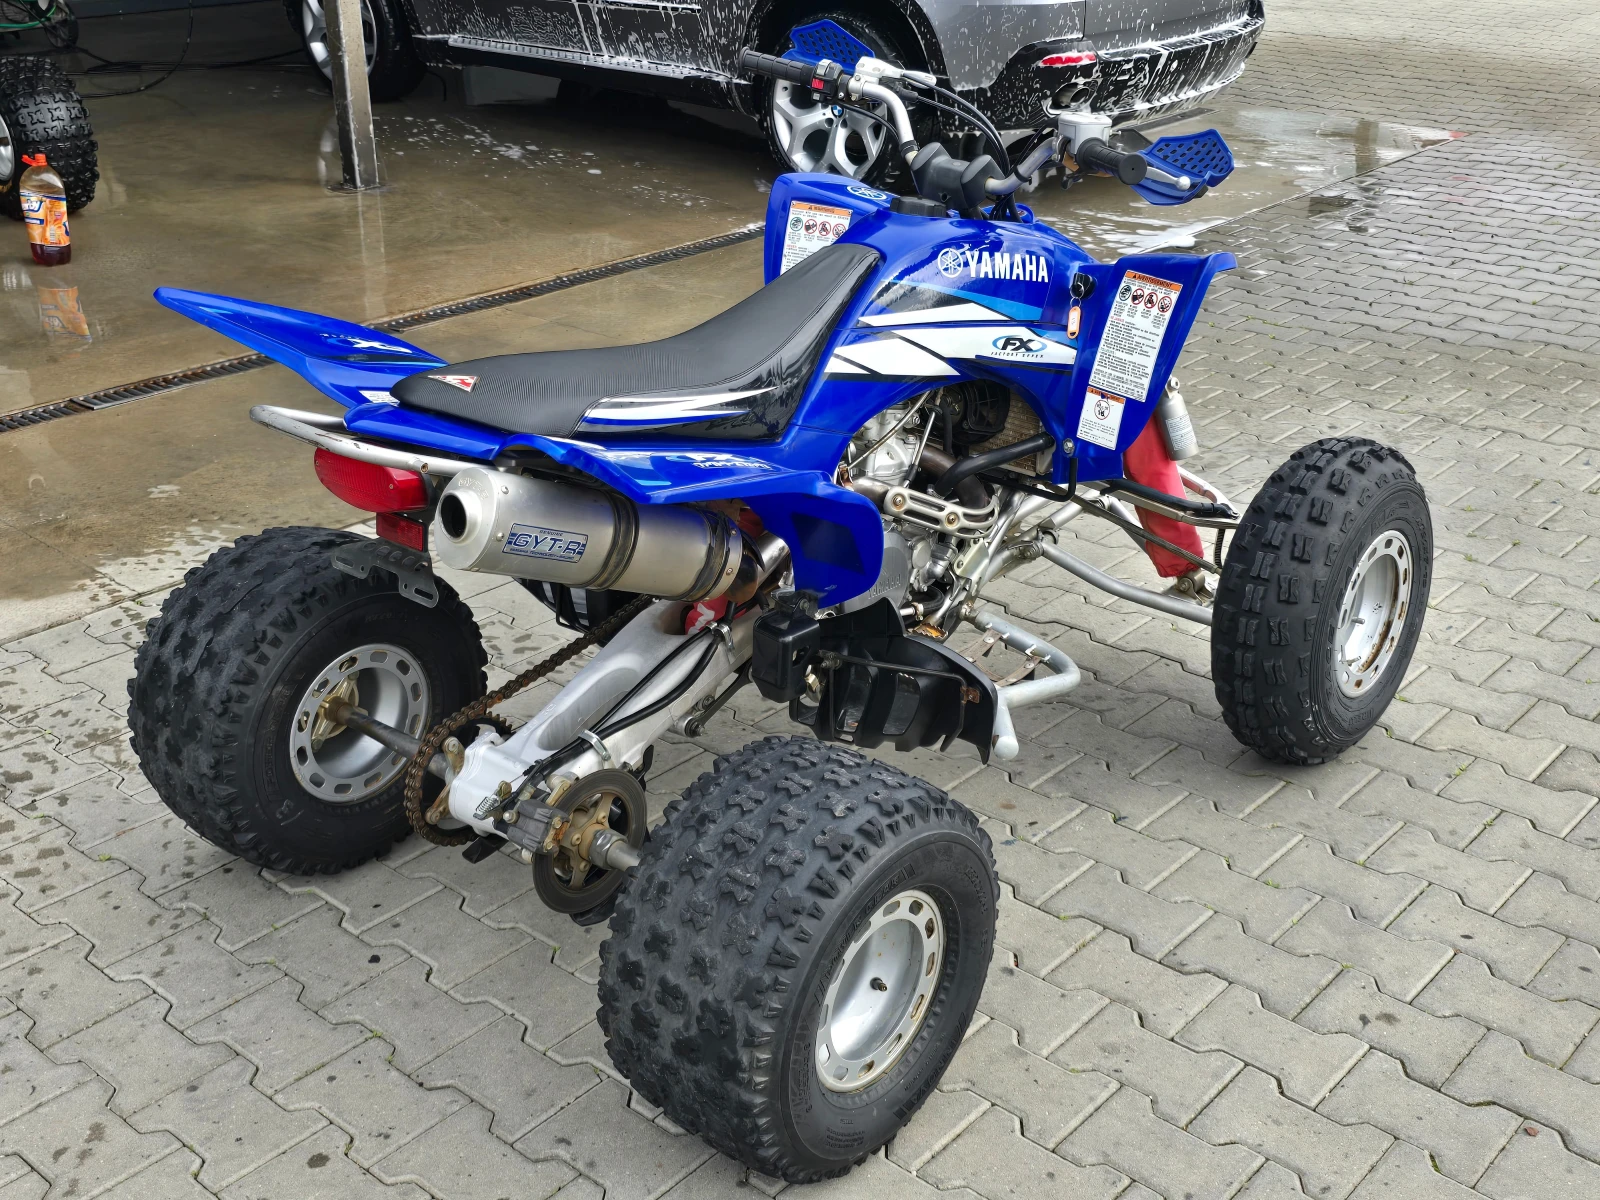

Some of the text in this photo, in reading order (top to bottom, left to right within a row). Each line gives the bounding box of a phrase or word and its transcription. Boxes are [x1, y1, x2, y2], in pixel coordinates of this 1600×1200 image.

[966, 251, 1049, 283] YAMAHA
[1000, 337, 1036, 352] FX
[868, 574, 901, 600] YAMAHA
